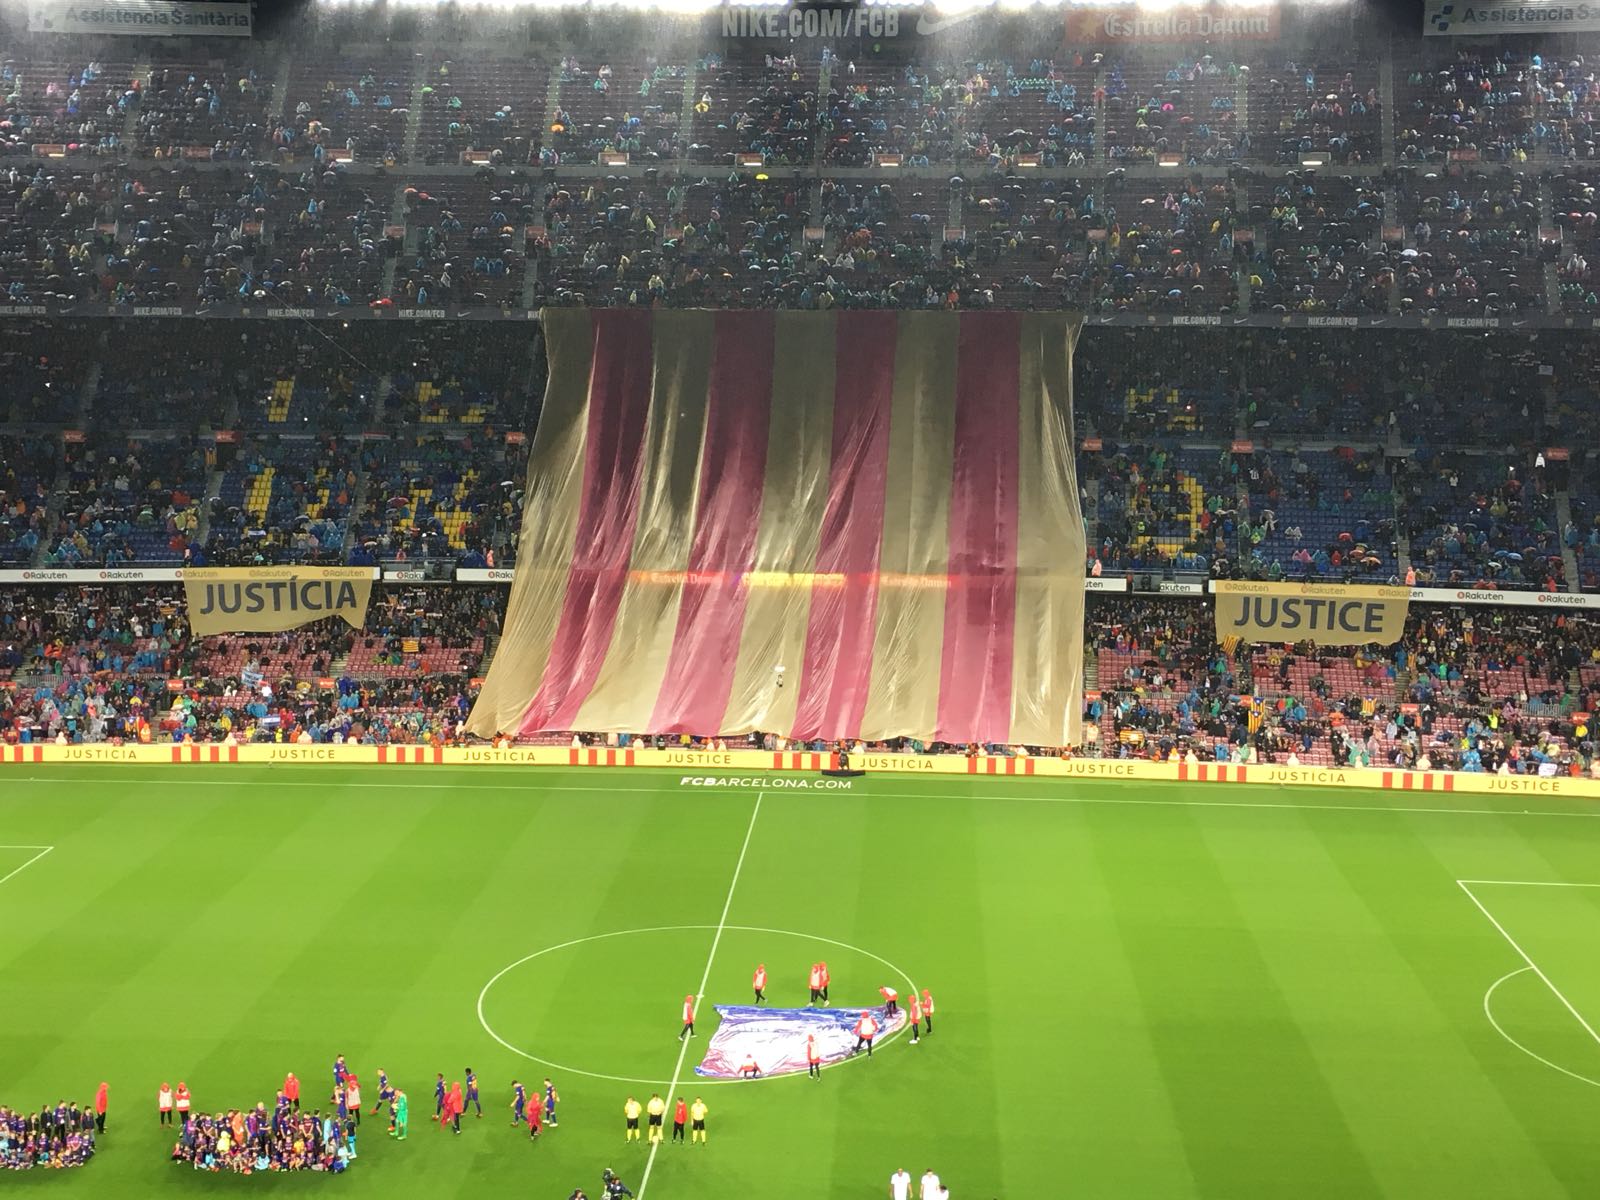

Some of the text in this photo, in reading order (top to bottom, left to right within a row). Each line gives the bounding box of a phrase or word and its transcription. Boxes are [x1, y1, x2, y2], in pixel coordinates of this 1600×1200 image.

[171, 9, 249, 27] Sanitària
[721, 8, 899, 37] NIKE.COM/FCB
[1104, 13, 1270, 38] Estrella Damm
[31, 571, 67, 579] Rakuten
[107, 571, 143, 579] Rakuten
[1160, 583, 1190, 592] akuten
[200, 575, 357, 615] JUSTÍCIA
[1465, 592, 1503, 601] Rakuten
[1546, 595, 1586, 604] Rakuten
[1234, 597, 1385, 632] JUSTICE
[270, 749, 335, 759] JUSTICE
[666, 753, 732, 765] JUSTICE
[1067, 763, 1135, 775] JUSTICE
[680, 776, 852, 789] FCBARCELONA.COM
[1488, 779, 1560, 792] JUSTICE
